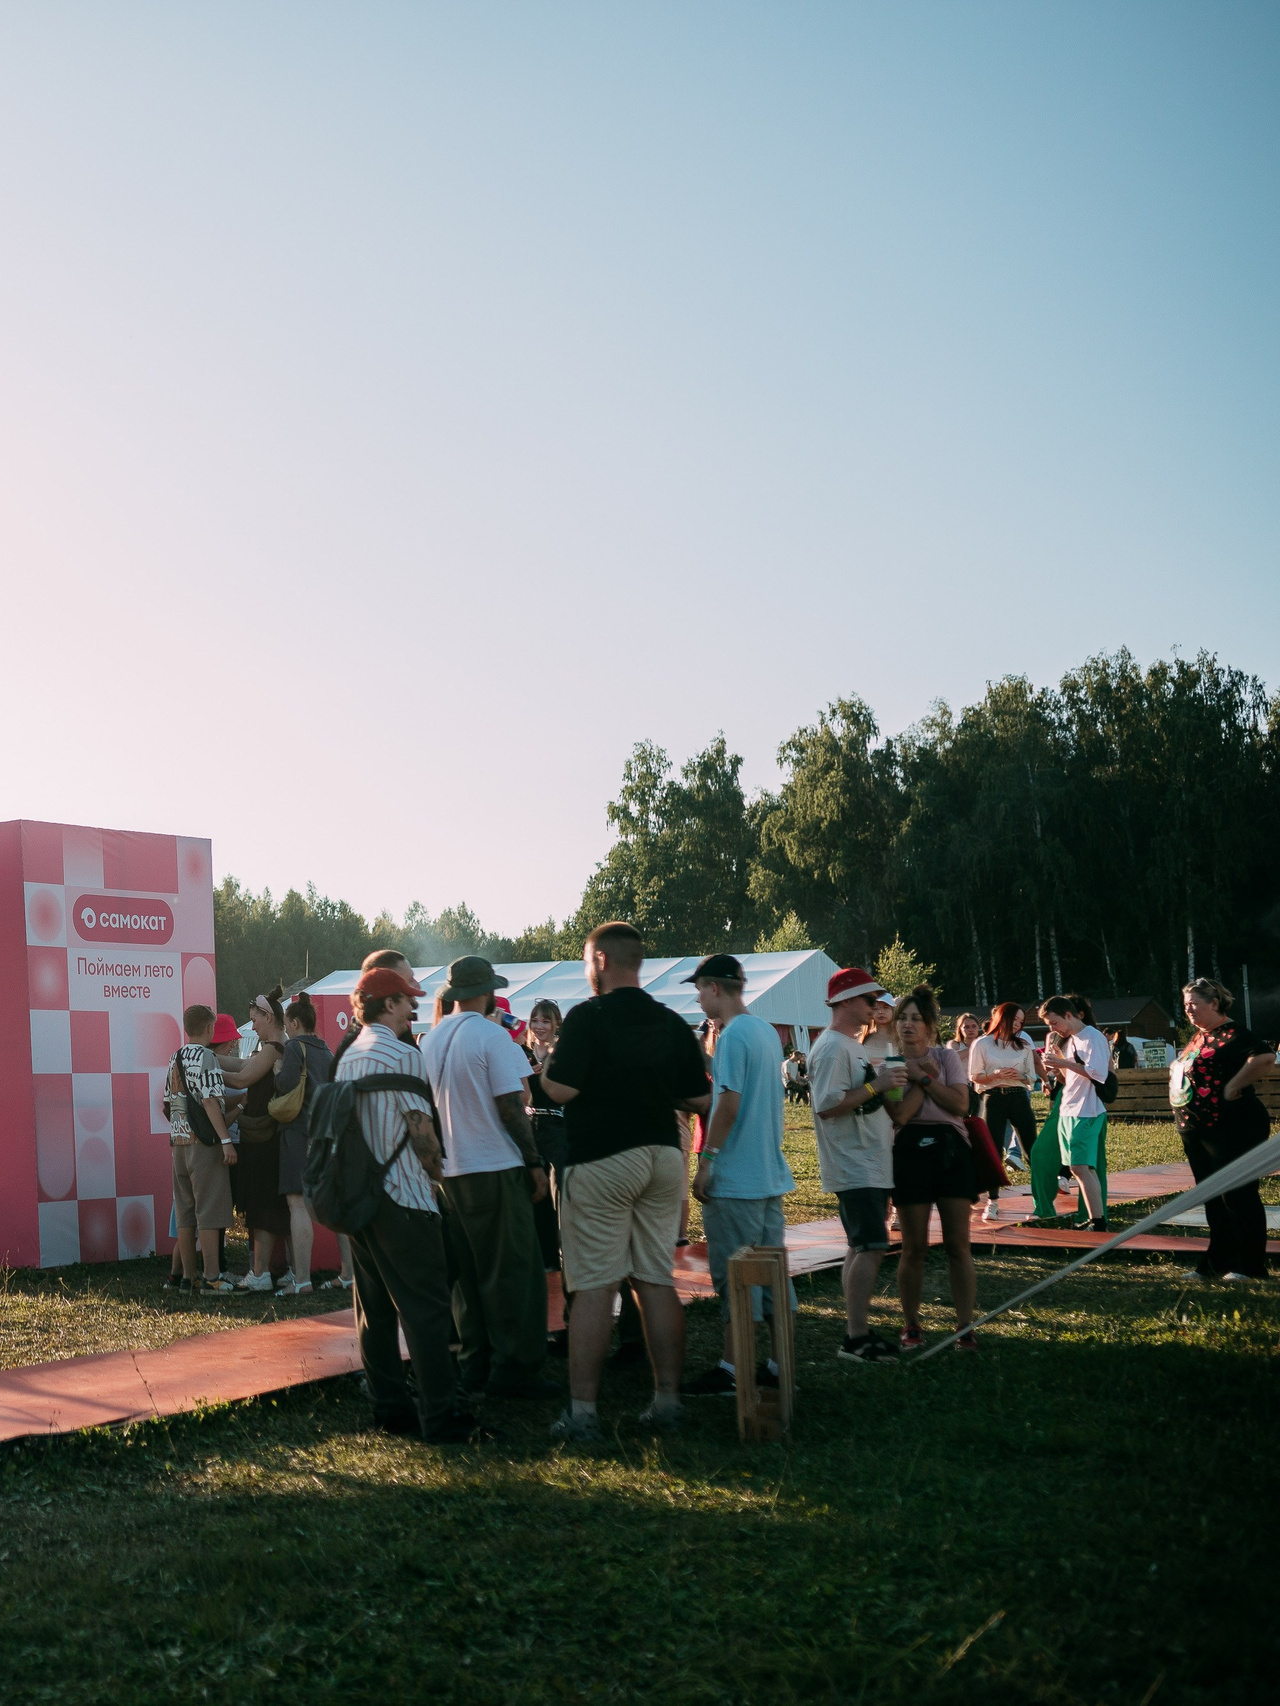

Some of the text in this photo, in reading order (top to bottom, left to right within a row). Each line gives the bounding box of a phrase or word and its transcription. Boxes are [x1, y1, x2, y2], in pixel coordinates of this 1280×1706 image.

[99, 912, 167, 931] самокат
[77, 957, 174, 978] Поймаем лето
[103, 985, 151, 999] вместе
